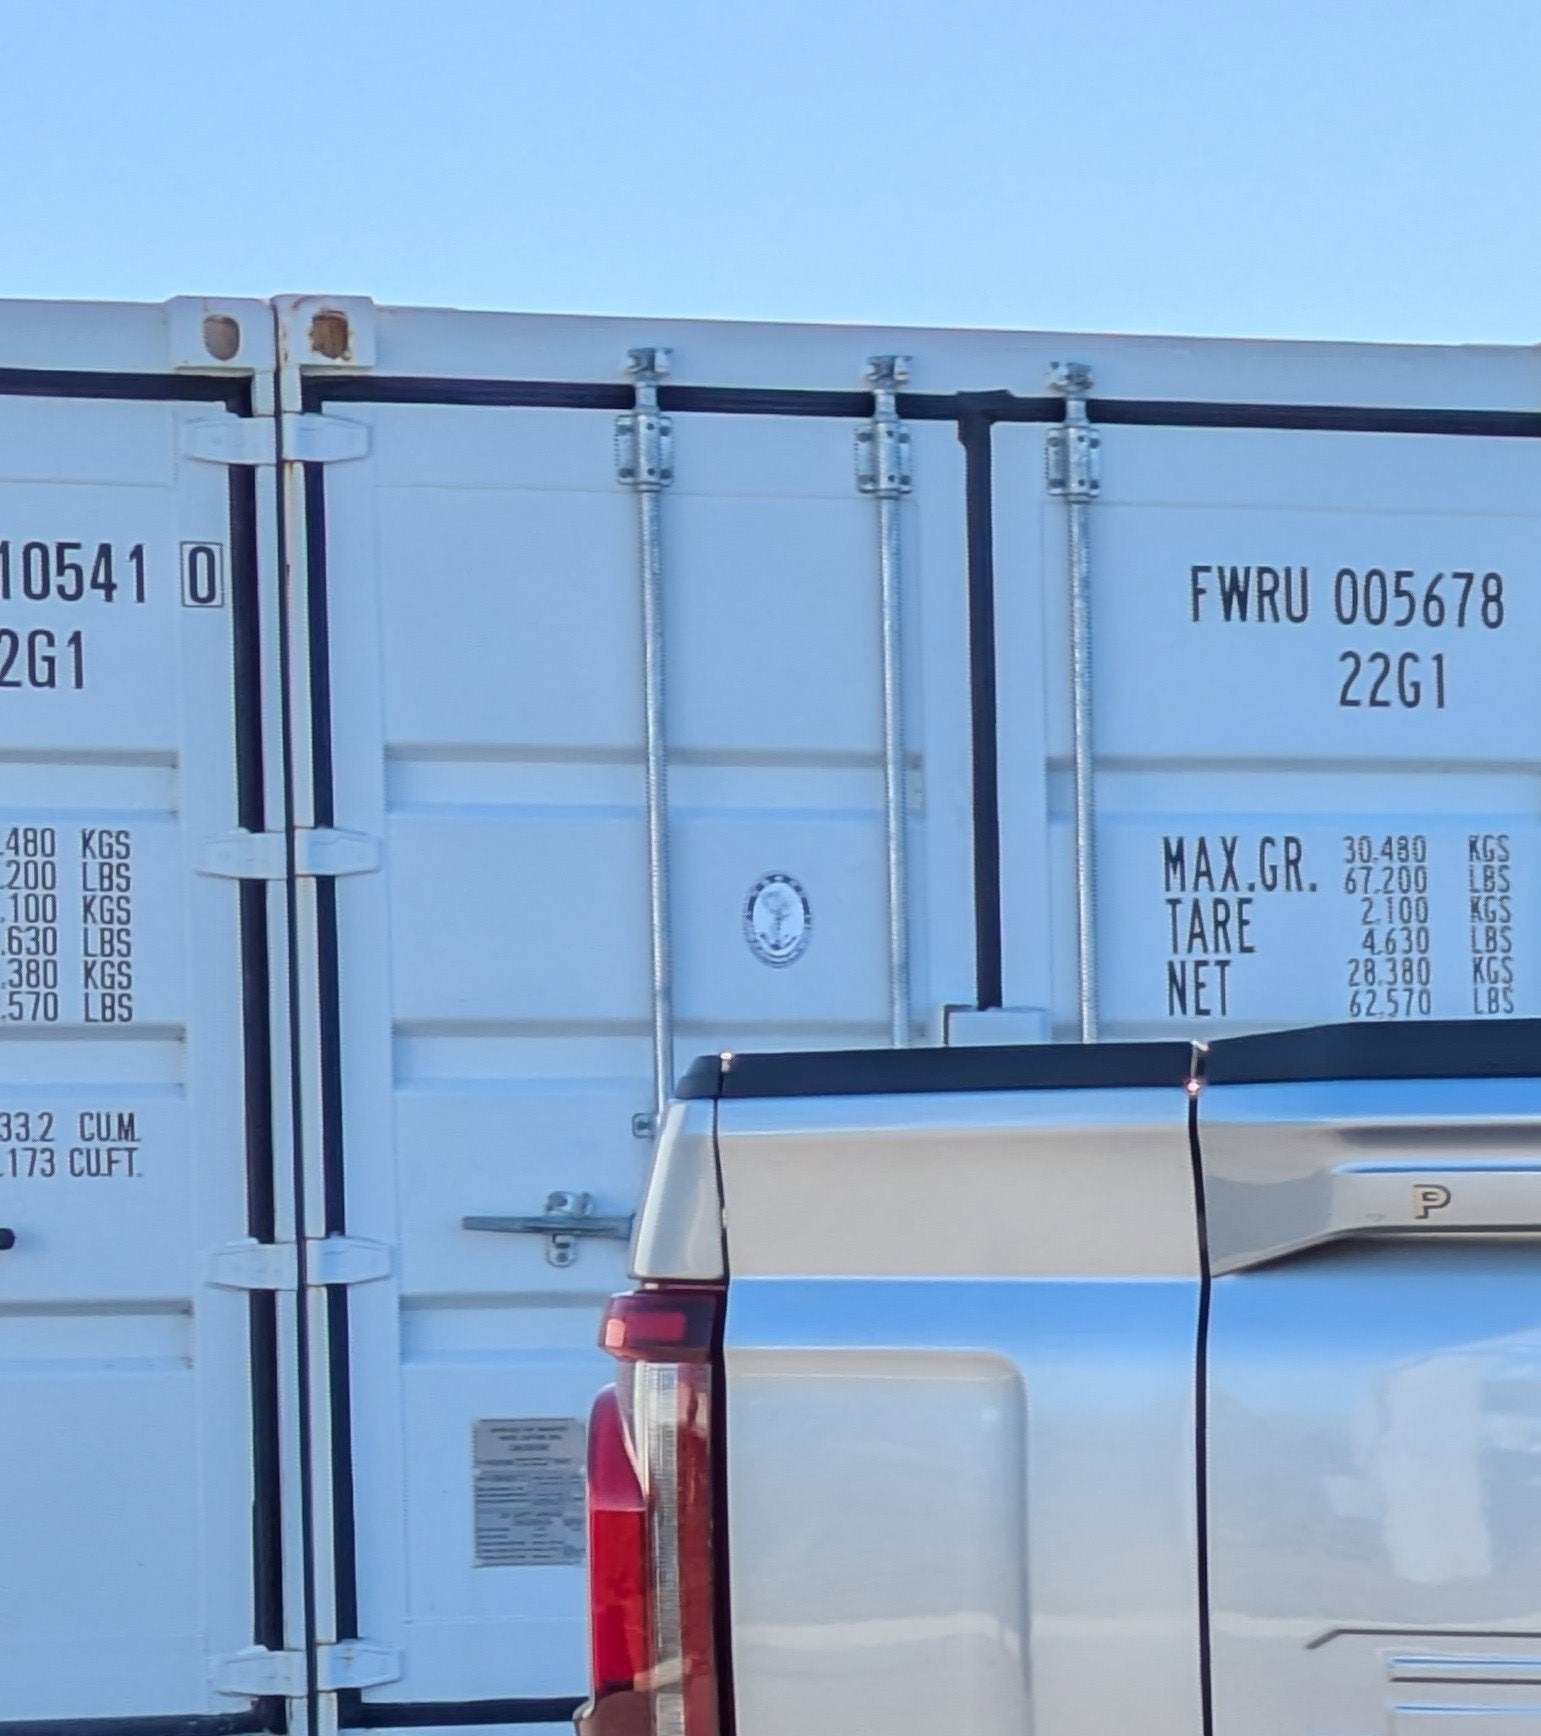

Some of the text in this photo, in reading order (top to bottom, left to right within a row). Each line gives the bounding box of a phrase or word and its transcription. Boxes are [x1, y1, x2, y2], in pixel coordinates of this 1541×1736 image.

[188, 545, 216, 604] 0
[1190, 565, 1310, 623] FWRU
[1334, 567, 1505, 629] 005678
[1338, 650, 1447, 709] 22G1
[81, 829, 131, 860] KGS
[1342, 834, 1511, 864] 30.480 KGS
[82, 861, 131, 892] LBS
[1162, 835, 1319, 892] MAX.GR.
[1344, 865, 1511, 895] 67.200 LBS
[82, 895, 131, 925] KGS
[1165, 897, 1257, 954] TARE
[1361, 895, 1512, 926] 2.100 KGS
[83, 927, 132, 957] LBS
[1361, 926, 1513, 956] 4.630 LBS
[83, 959, 132, 990] KGS
[1348, 956, 1514, 987] 28.380 KGS
[1167, 959, 1233, 1017] NET
[1349, 986, 1515, 1018] 62.570 LBS
[84, 992, 133, 1023] LBS
